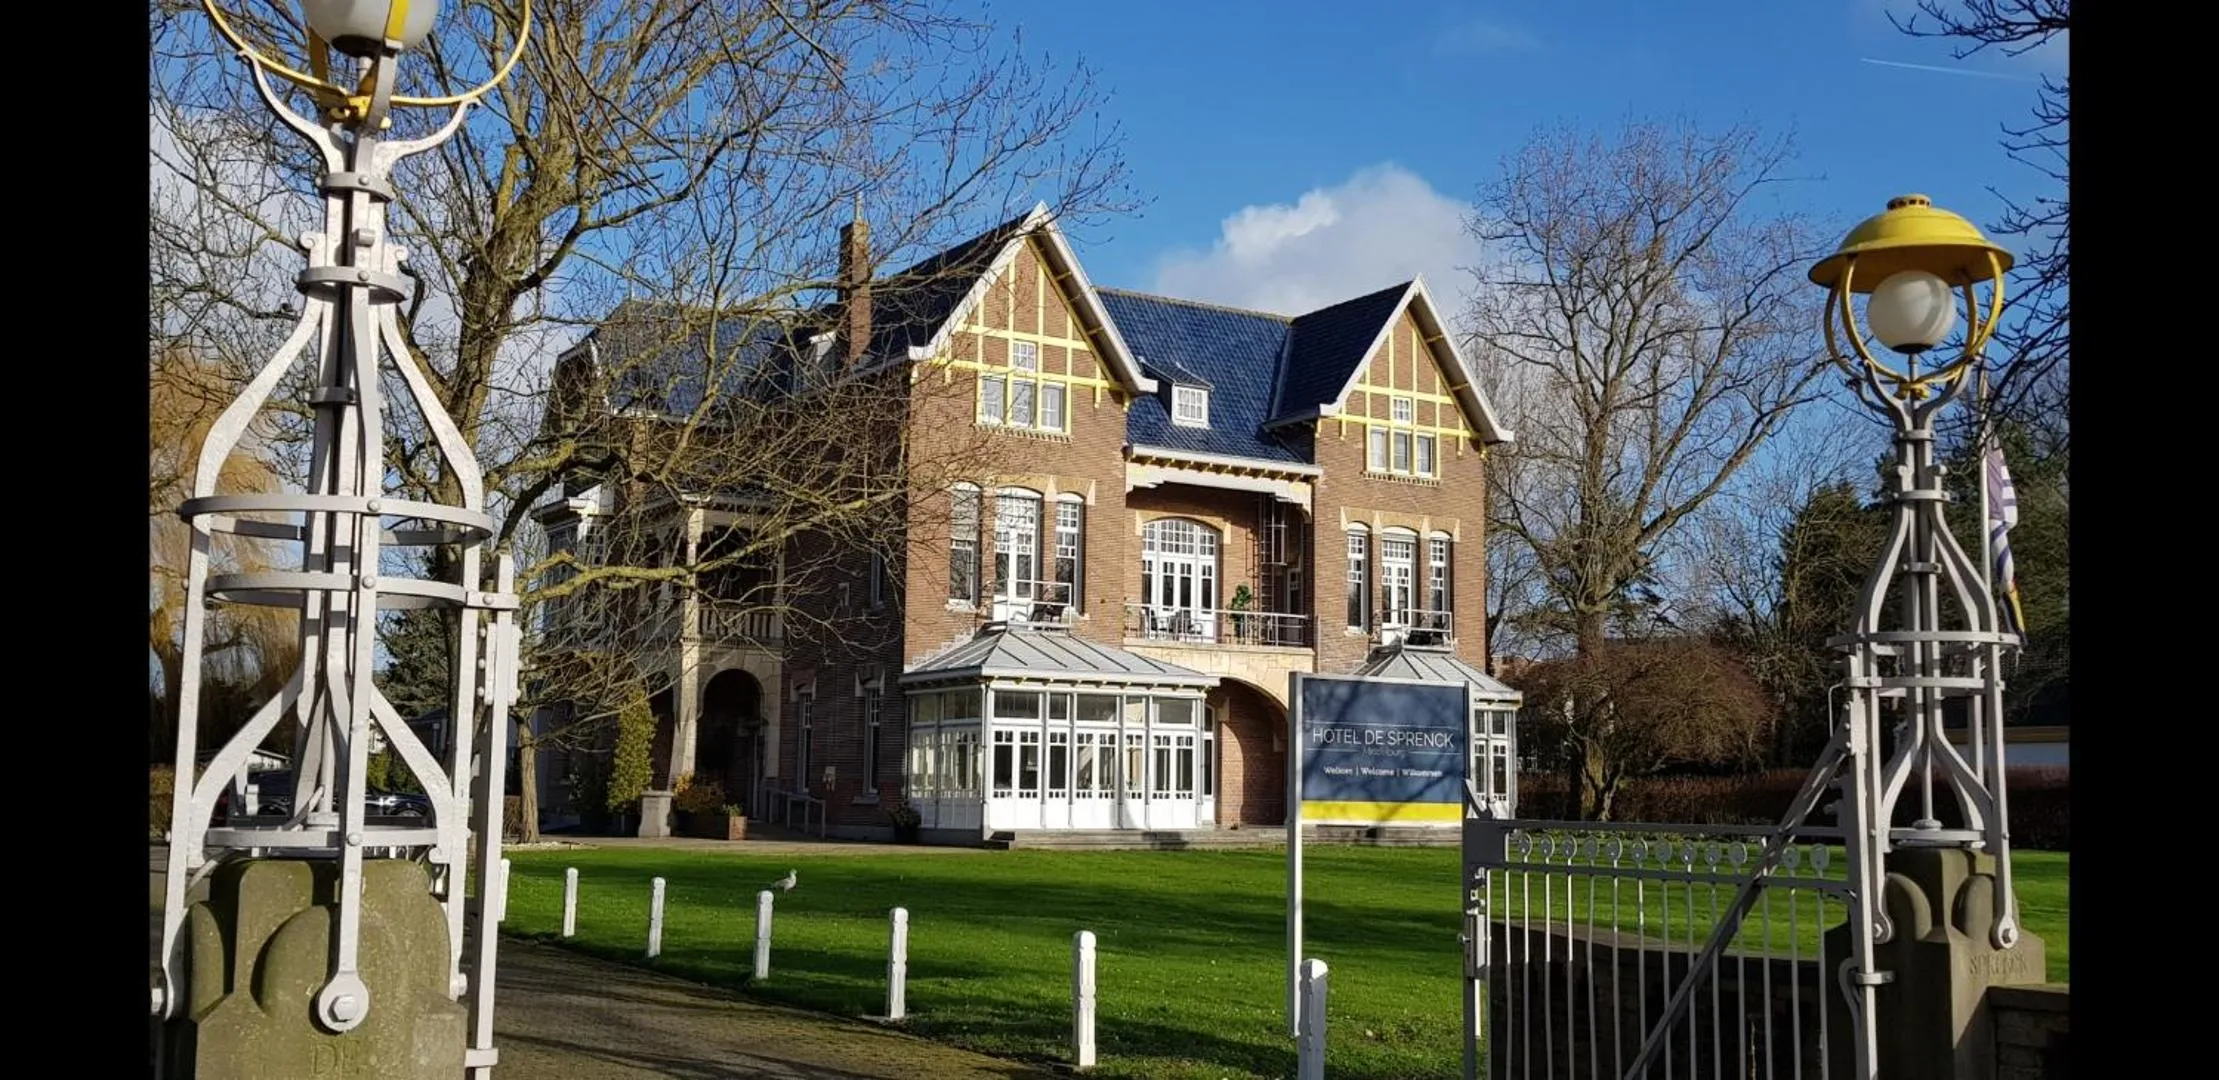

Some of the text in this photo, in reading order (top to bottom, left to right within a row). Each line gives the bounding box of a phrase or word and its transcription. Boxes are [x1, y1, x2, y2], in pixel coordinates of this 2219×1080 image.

[1313, 728, 1454, 748] HOTEL DE SPRENCK
